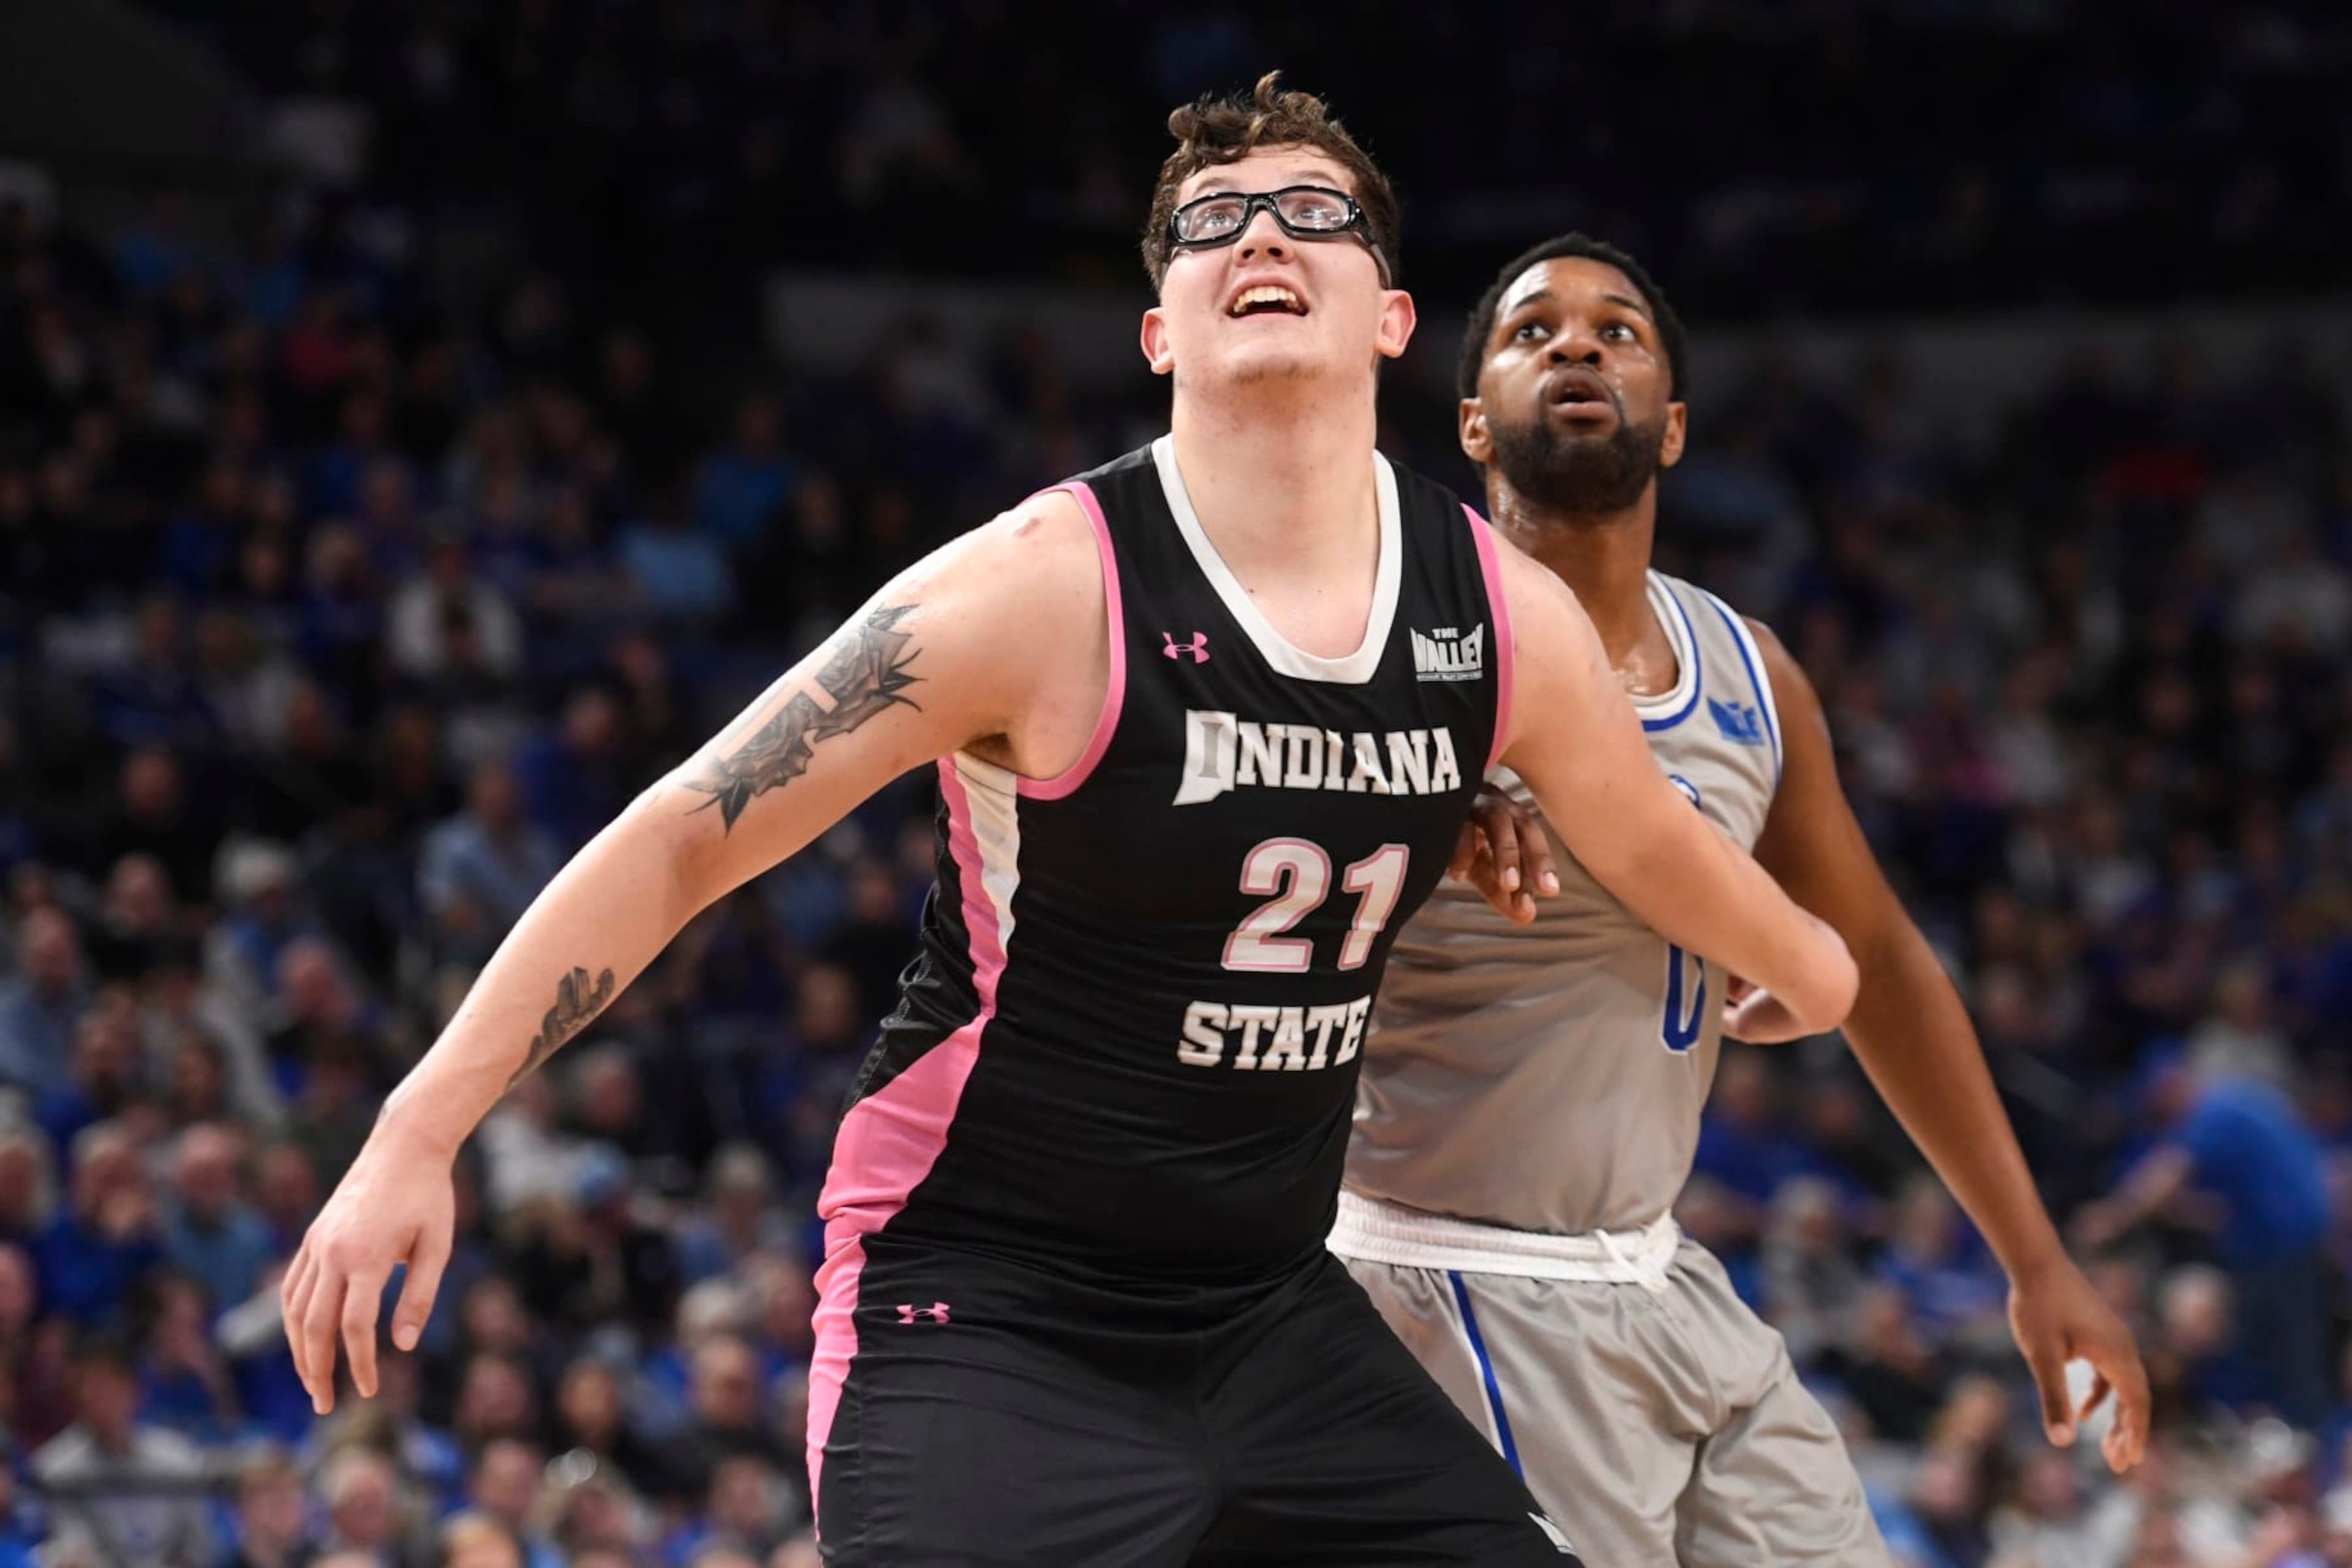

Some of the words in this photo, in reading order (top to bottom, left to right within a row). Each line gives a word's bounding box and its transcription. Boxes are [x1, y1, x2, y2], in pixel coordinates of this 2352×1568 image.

[1410, 622, 1483, 673] VALLEY
[1432, 627, 1459, 639] THE
[1172, 709, 1461, 805] INDIANA
[1221, 837, 1410, 973] 21
[1177, 994, 1371, 1071] STATE
